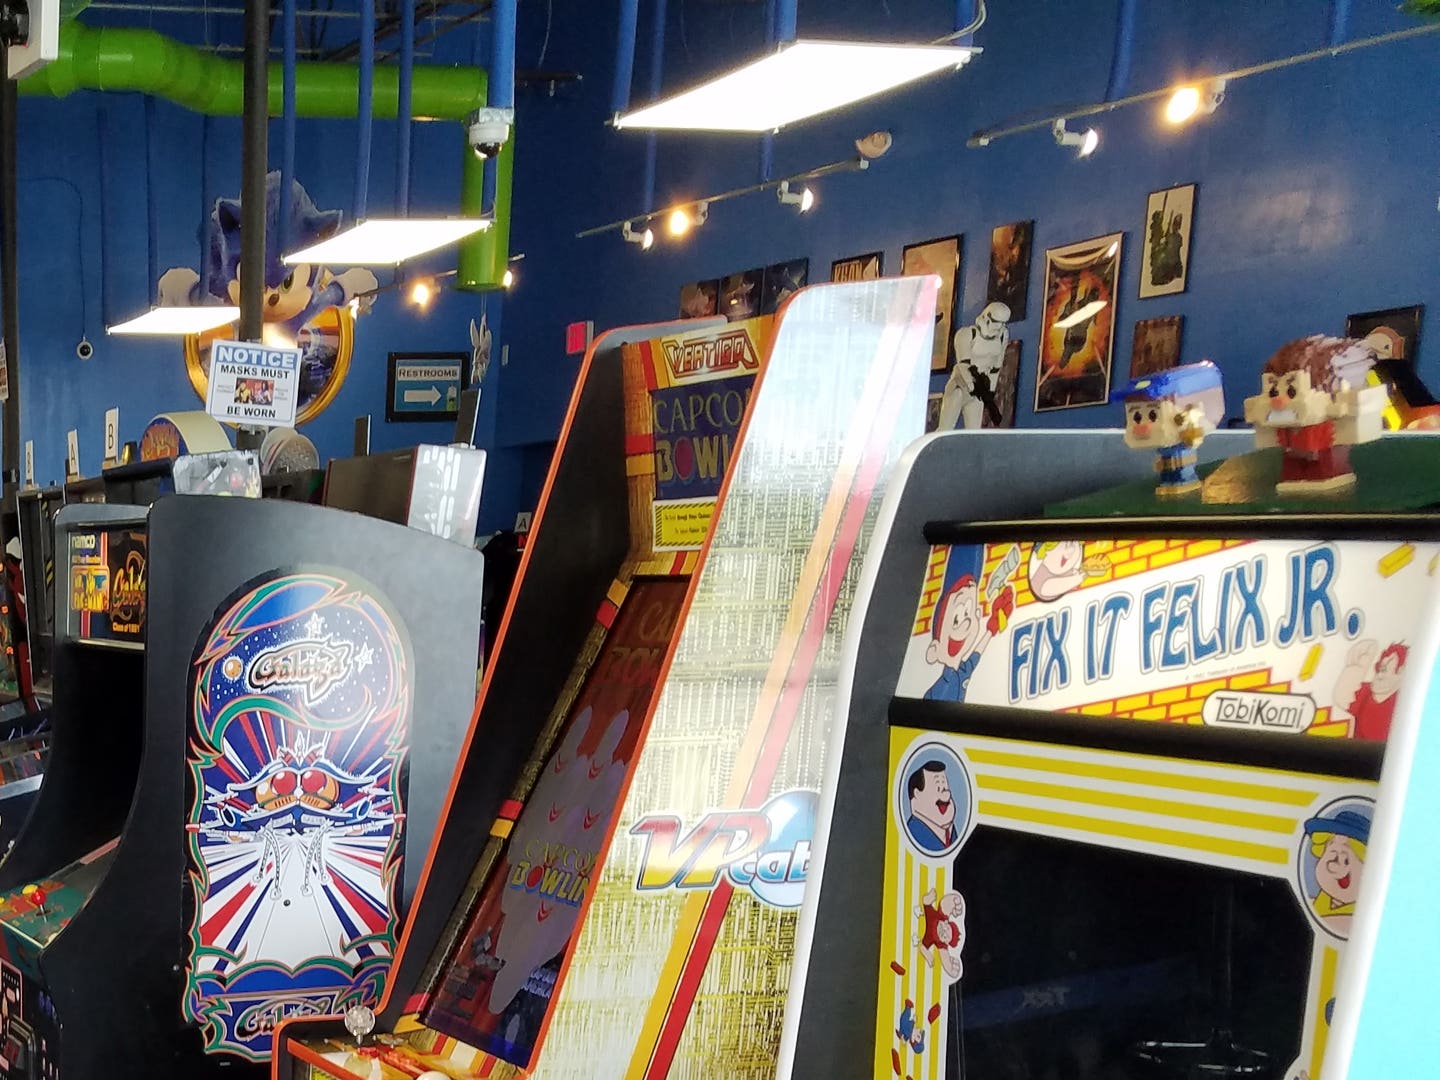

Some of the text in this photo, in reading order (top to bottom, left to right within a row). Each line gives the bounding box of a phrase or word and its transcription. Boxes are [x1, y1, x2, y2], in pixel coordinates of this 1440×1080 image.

[218, 347, 295, 368] NOTICE
[221, 365, 289, 379] MASKS MUST
[399, 367, 457, 378] RESTROOMS
[227, 406, 275, 418] BE WORN
[654, 388, 751, 433] CAPCO
[108, 424, 114, 450] B
[70, 444, 76, 461] A
[72, 535, 96, 549] namco
[1011, 546, 1360, 701] FIX IT FELIX JR.
[251, 642, 351, 702] Galaga
[1216, 697, 1304, 728] TobiKomi
